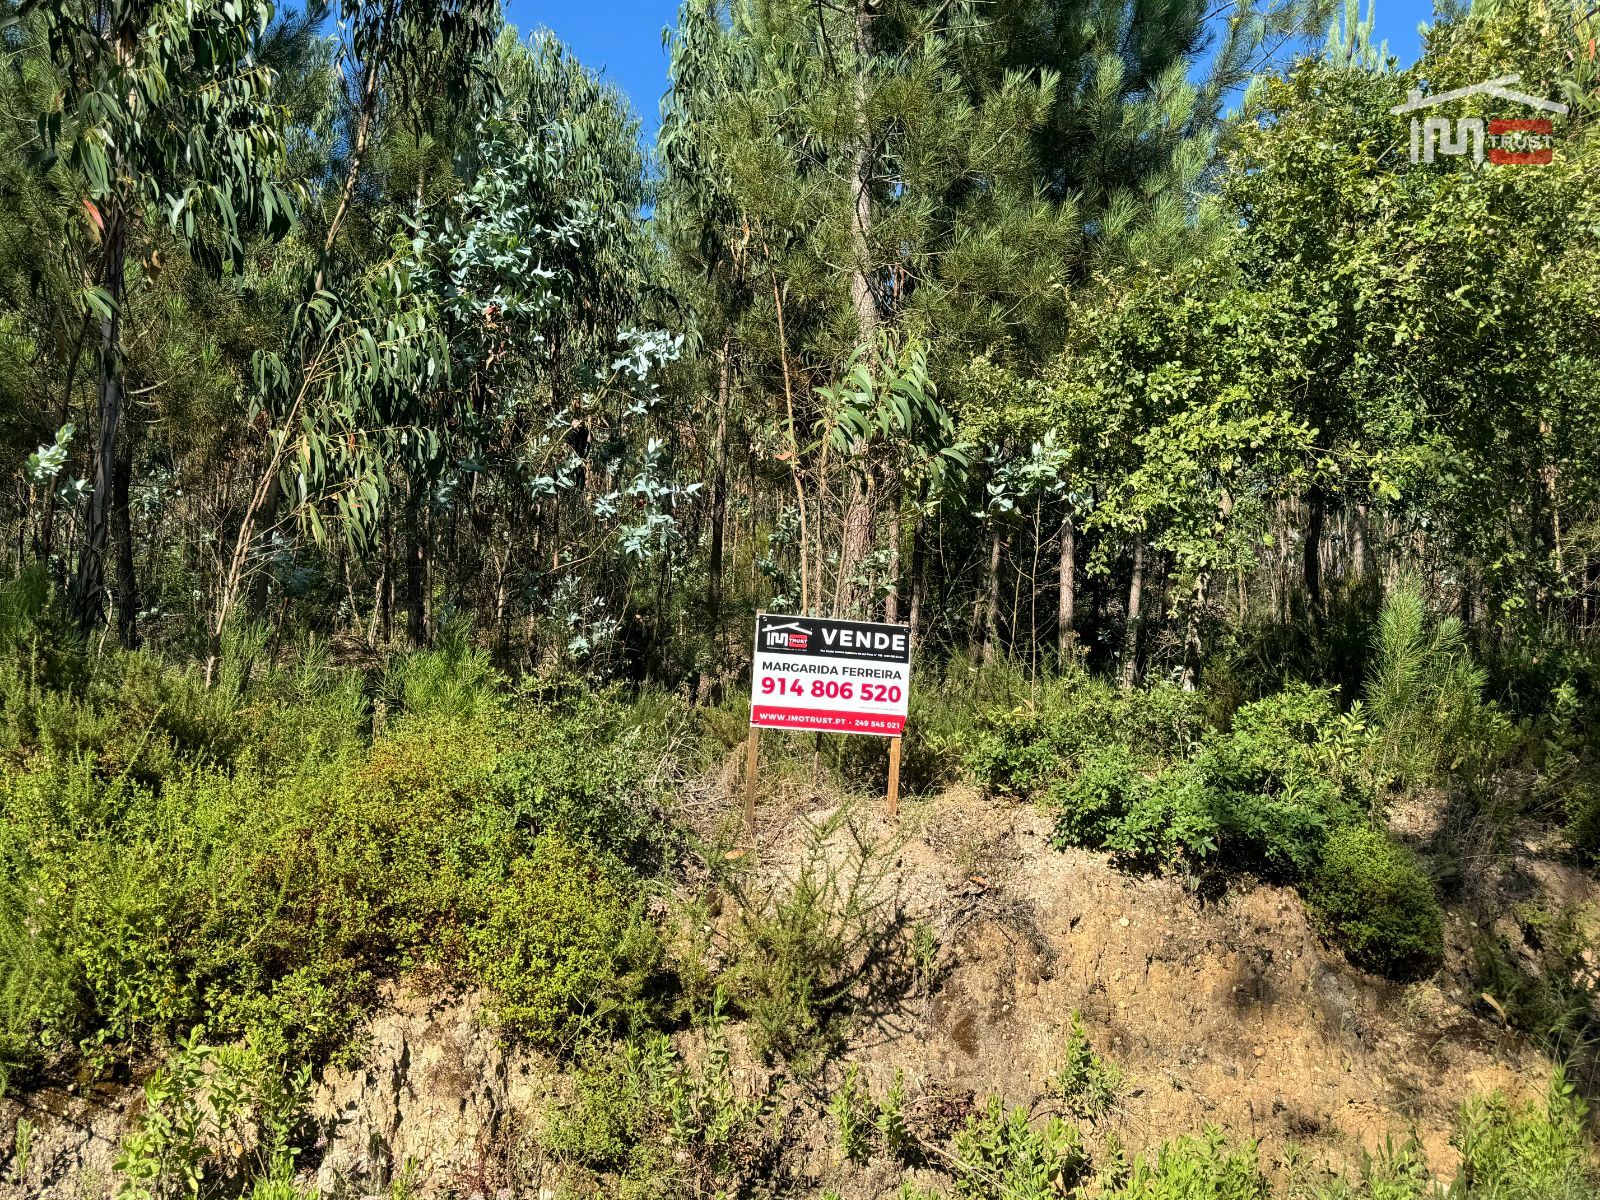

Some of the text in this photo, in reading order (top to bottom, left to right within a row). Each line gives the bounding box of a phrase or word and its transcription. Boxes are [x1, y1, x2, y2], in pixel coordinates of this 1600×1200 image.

[821, 628, 905, 650] VENDE
[762, 661, 902, 680] MARGARIDA FERREIRA
[761, 677, 901, 703] 914 806 520
[759, 712, 846, 725] WWW.IMOTRUST.PT
[855, 719, 869, 727] 249
